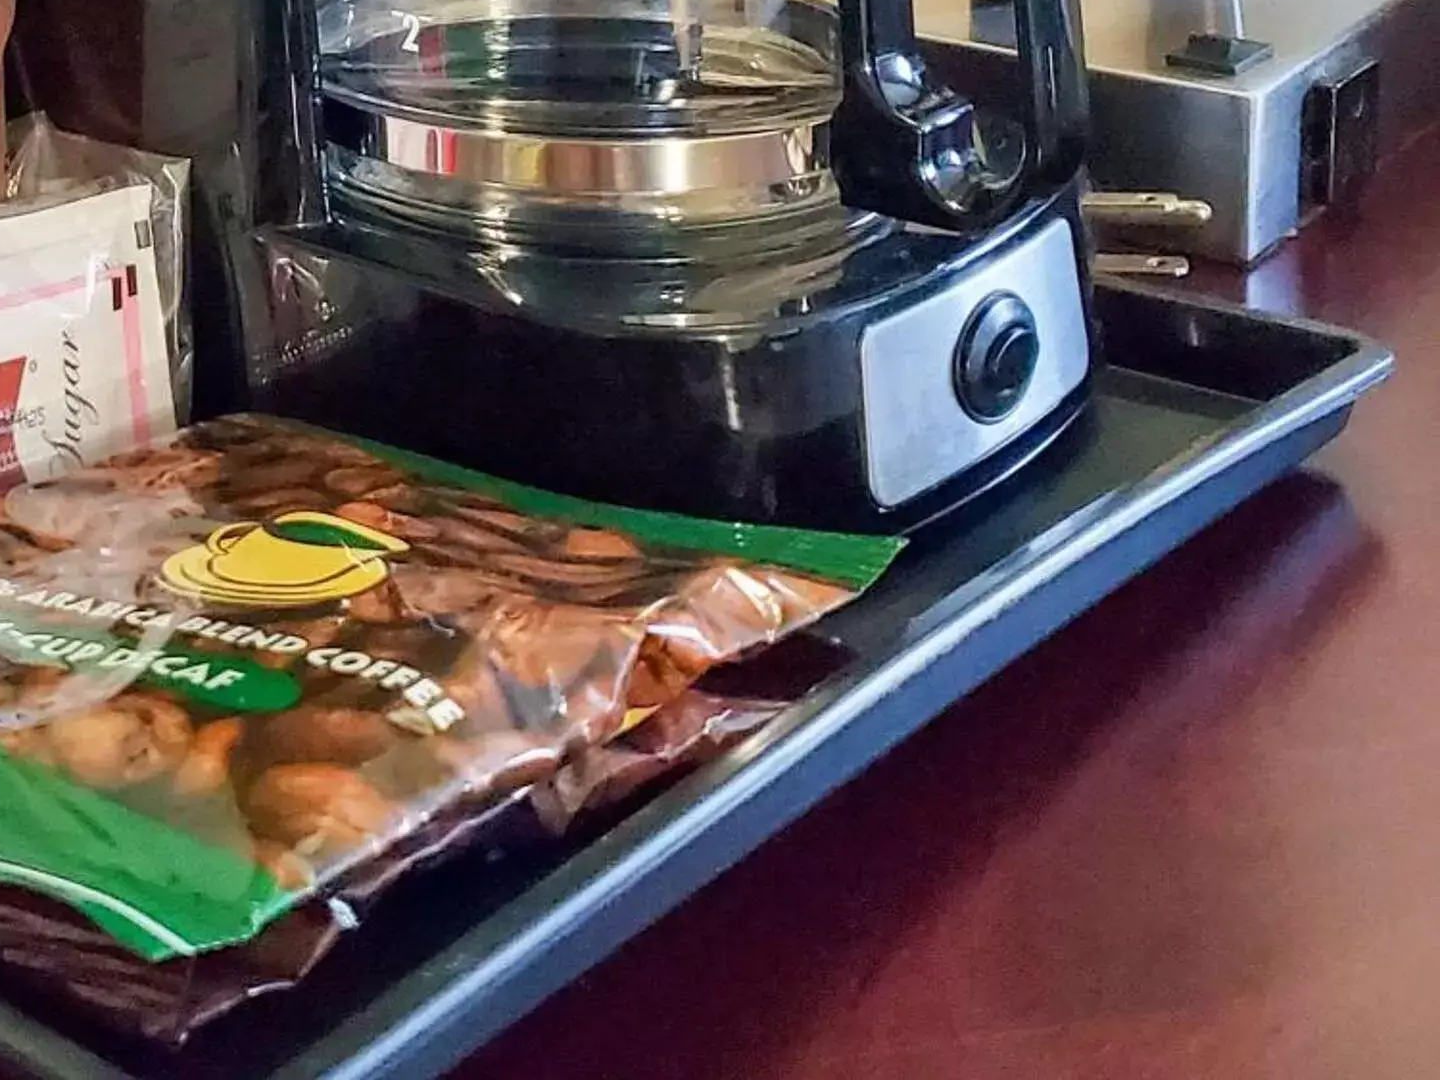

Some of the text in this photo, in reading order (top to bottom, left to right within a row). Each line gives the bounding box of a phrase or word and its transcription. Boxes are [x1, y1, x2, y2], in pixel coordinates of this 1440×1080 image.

[401, 14, 421, 53] 2
[41, 328, 100, 476] Sugar
[17, 589, 174, 628] ARABICA
[175, 615, 310, 653] BLEND
[306, 646, 466, 732] COFFEE
